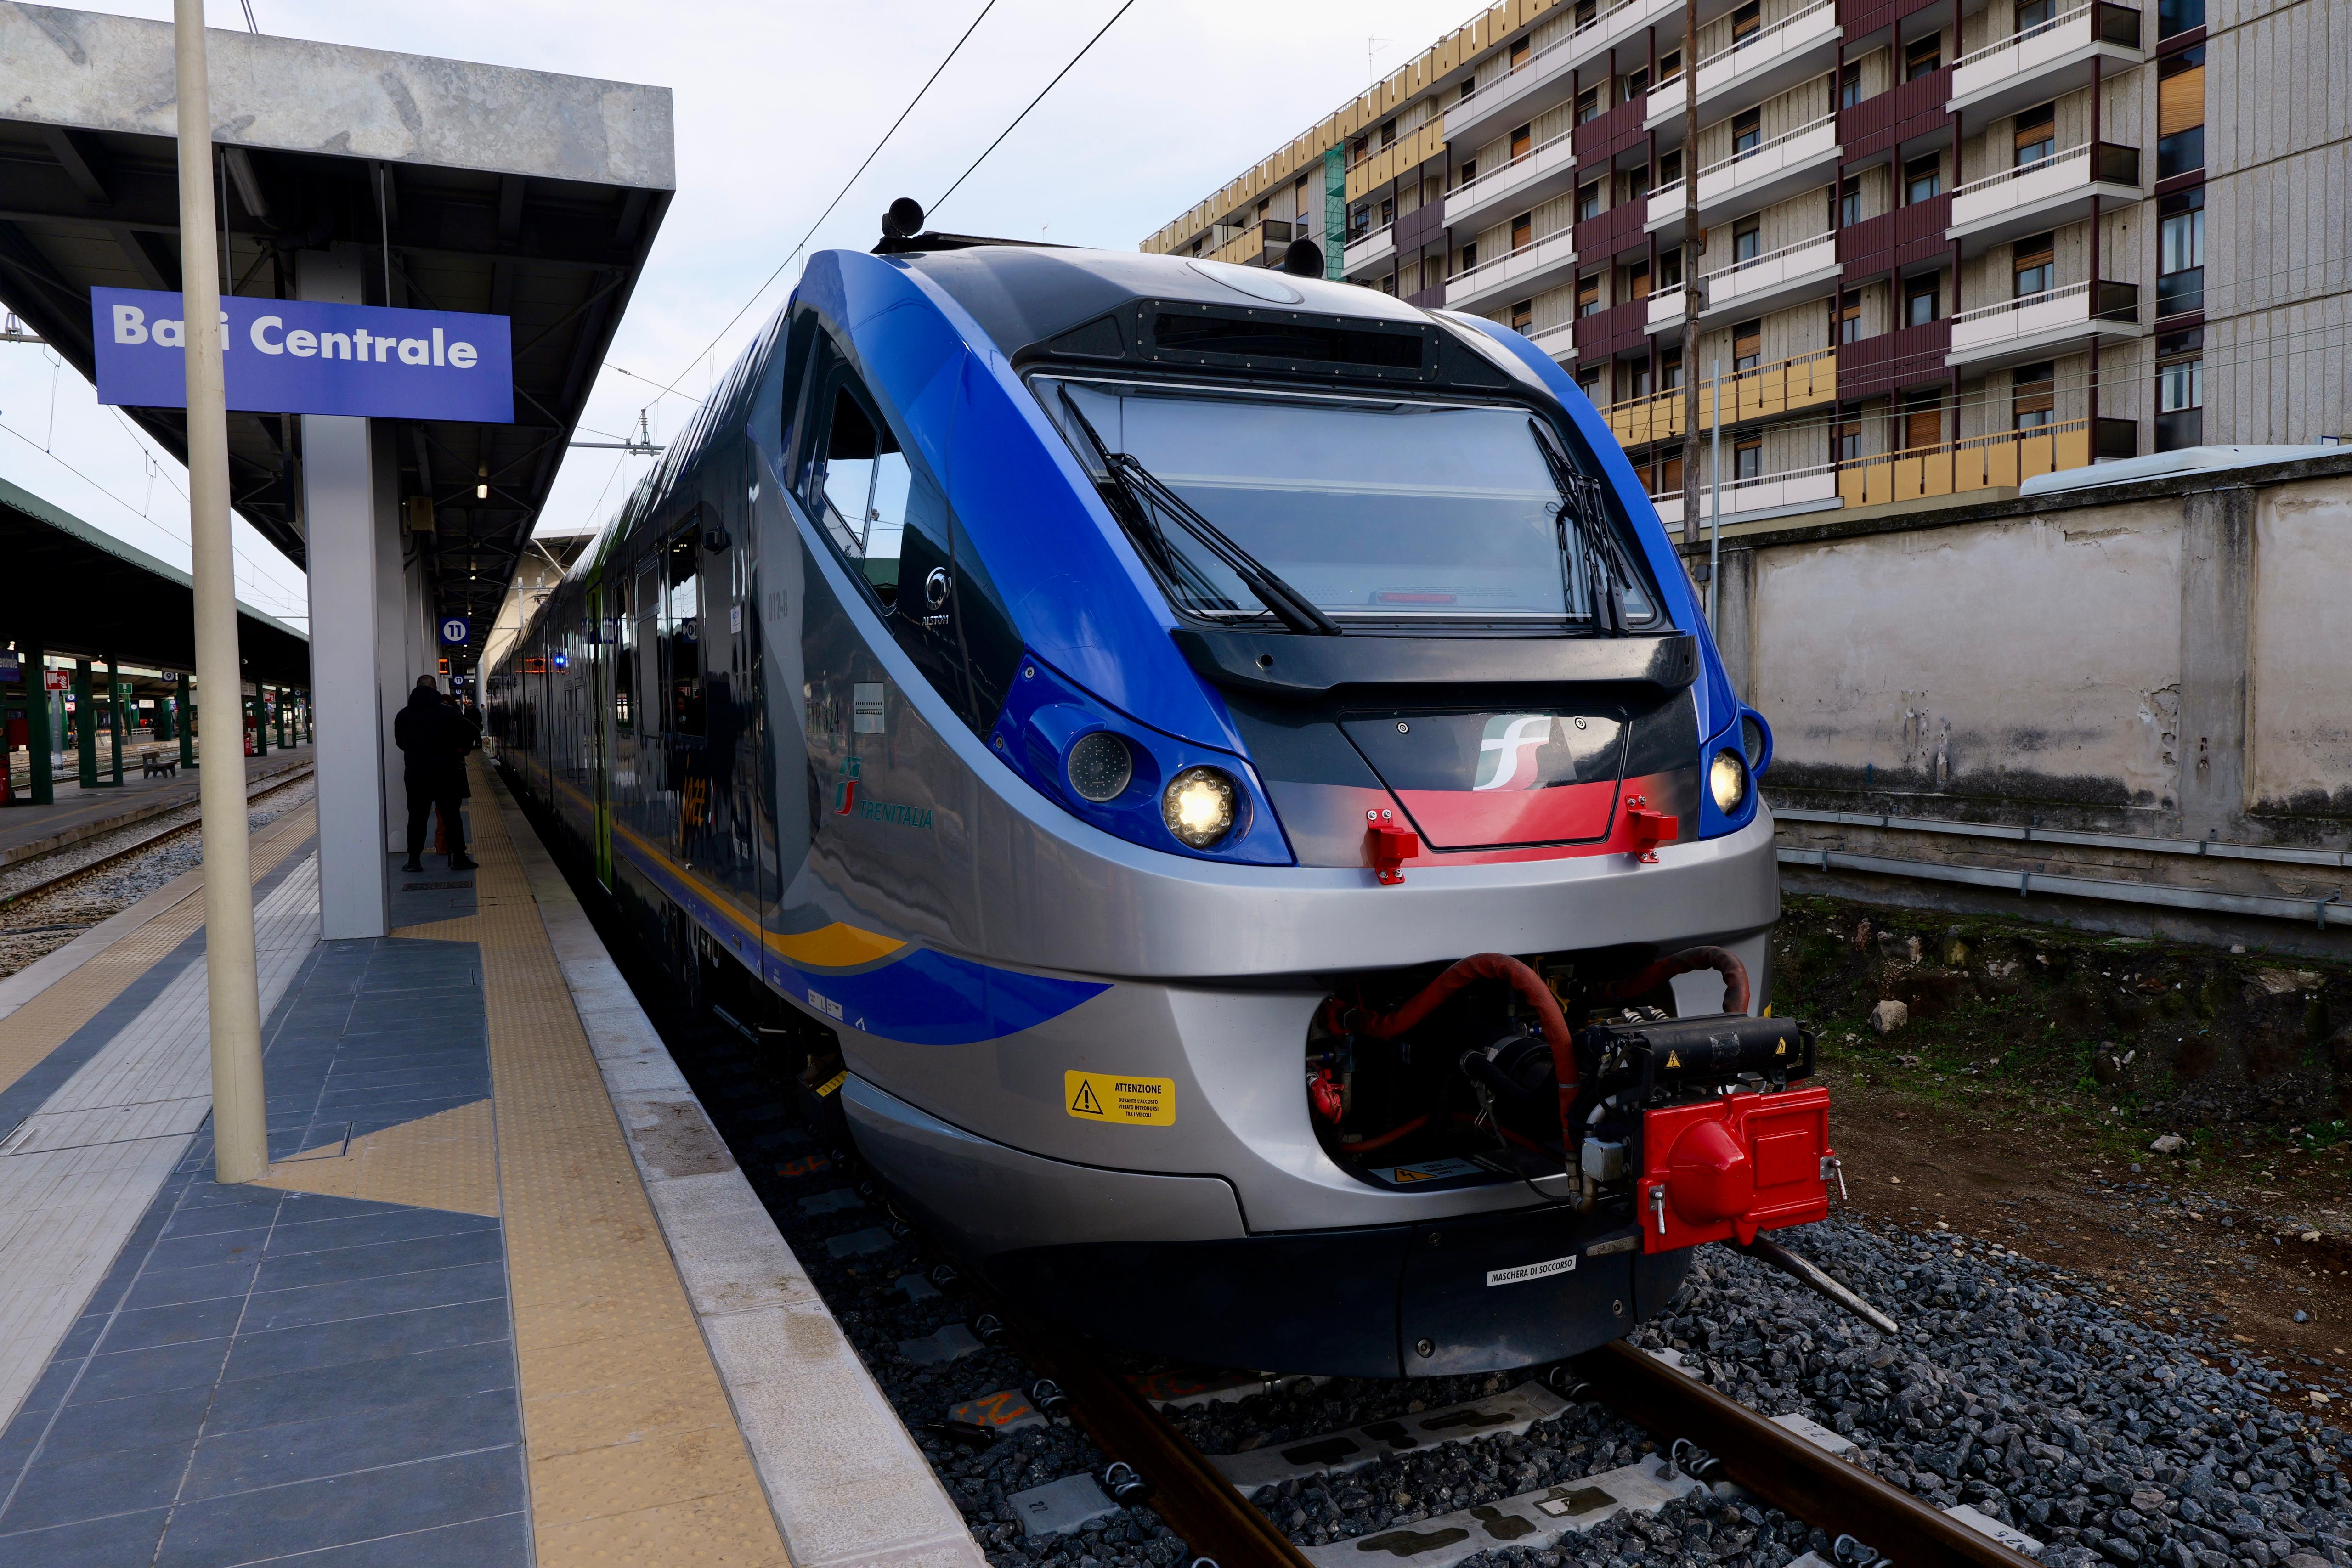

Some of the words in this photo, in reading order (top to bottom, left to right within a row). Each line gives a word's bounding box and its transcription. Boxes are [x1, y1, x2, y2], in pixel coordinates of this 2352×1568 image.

[113, 305, 229, 350] Bai
[250, 315, 478, 369] Centrale
[922, 615, 949, 626] ALSTOM
[448, 625, 461, 637] 11
[860, 800, 933, 829] TRENITALIA
[1115, 1083, 1161, 1094] ATTENZIONE
[1492, 1269, 1528, 1282] MASCHERA
[1530, 1267, 1538, 1276] DI
[1539, 1259, 1572, 1274] SOCCORSO
